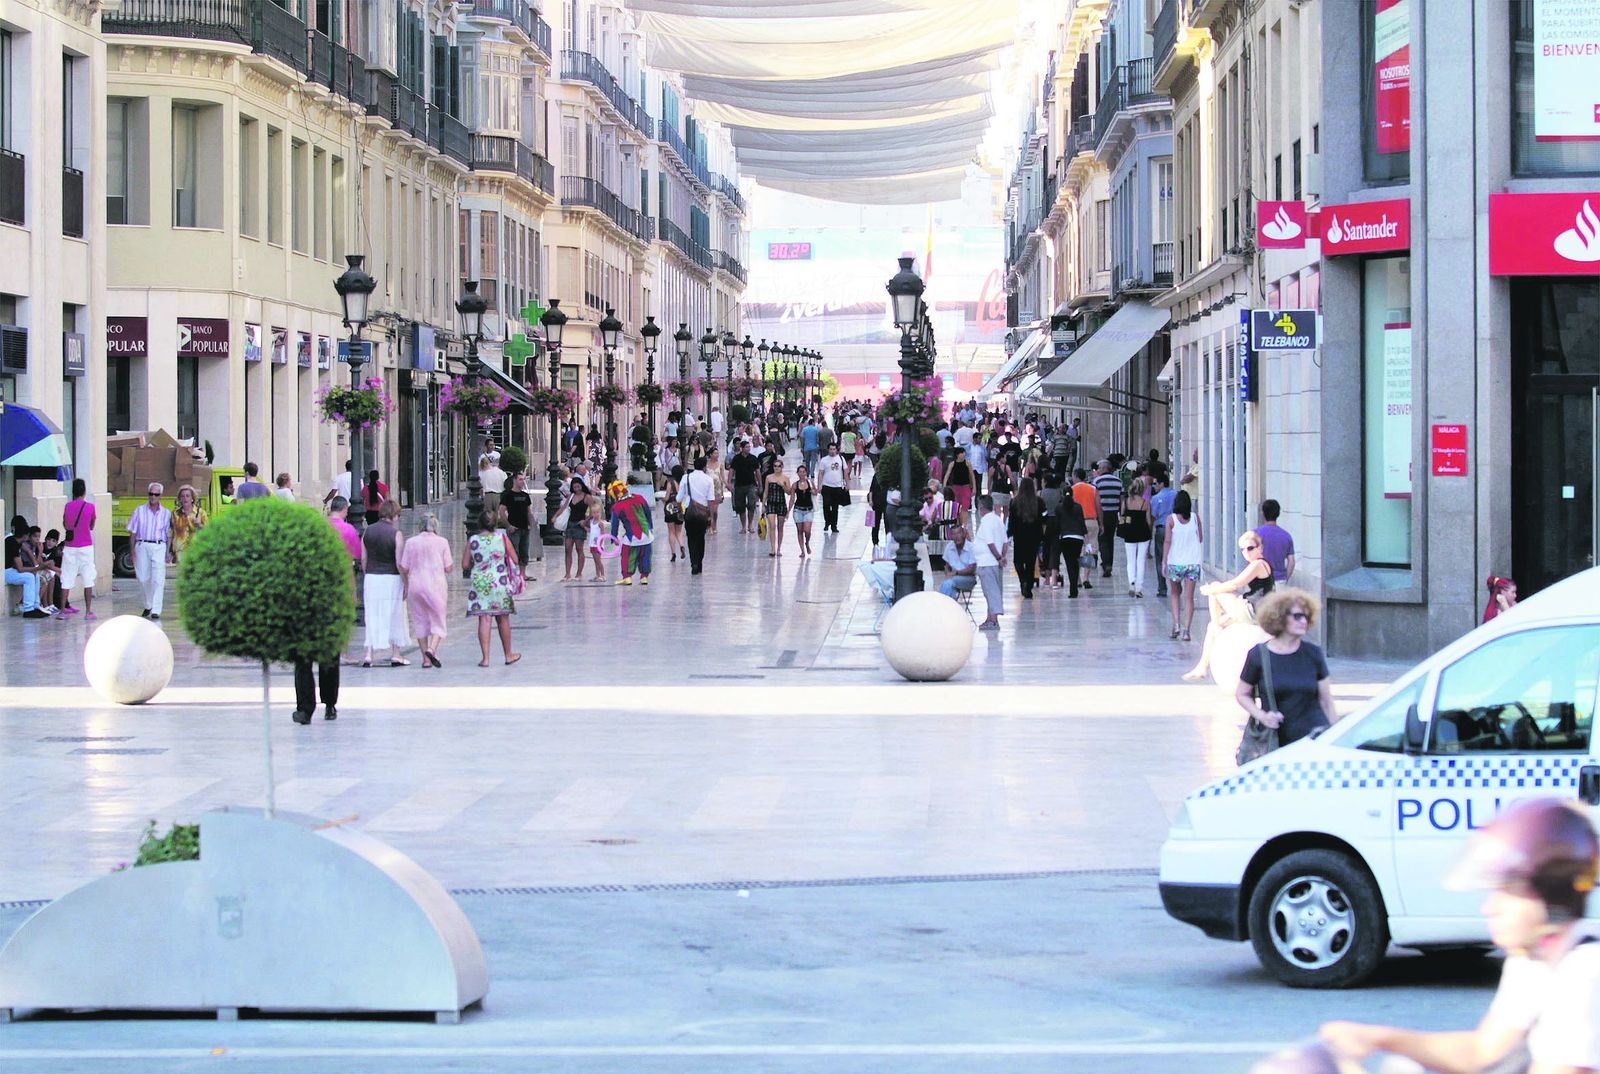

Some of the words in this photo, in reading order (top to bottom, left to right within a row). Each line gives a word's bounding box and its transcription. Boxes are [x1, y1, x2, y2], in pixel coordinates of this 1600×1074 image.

[1343, 213, 1398, 241] Santander
[192, 325, 213, 334] BANCO
[192, 340, 229, 352] POPULAR
[1261, 336, 1309, 347] TELEBANCO
